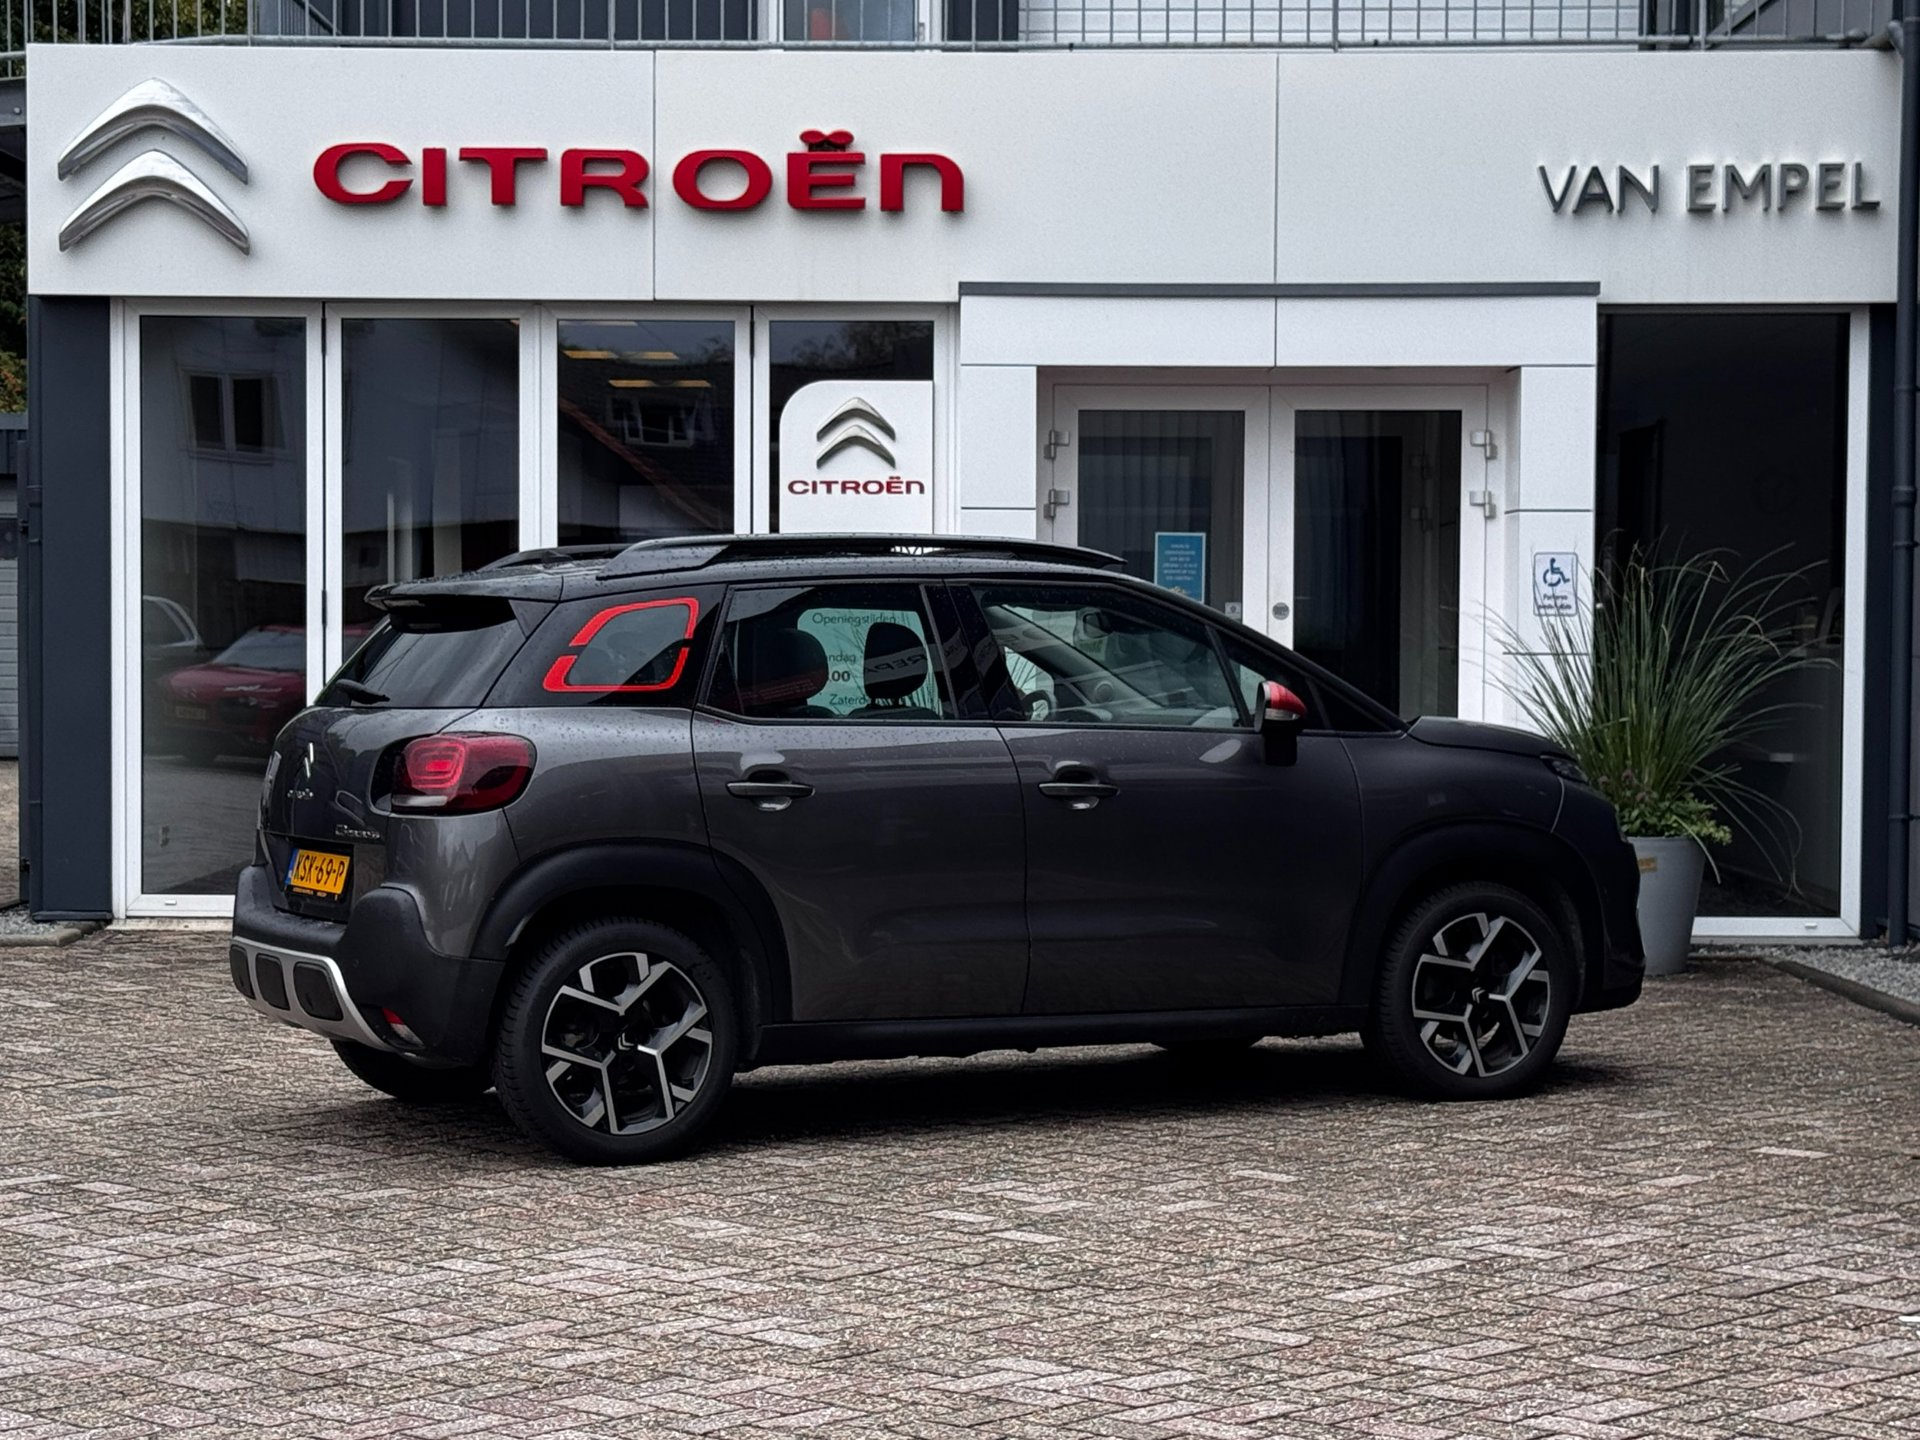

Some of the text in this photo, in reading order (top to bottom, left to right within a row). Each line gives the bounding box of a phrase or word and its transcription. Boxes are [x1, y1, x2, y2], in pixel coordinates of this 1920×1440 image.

[1538, 161, 1881, 214] VAN EMPEL
[828, 650, 856, 665] ndag
[829, 693, 868, 706] Zaterd
[294, 854, 345, 887] KSK-69-P
